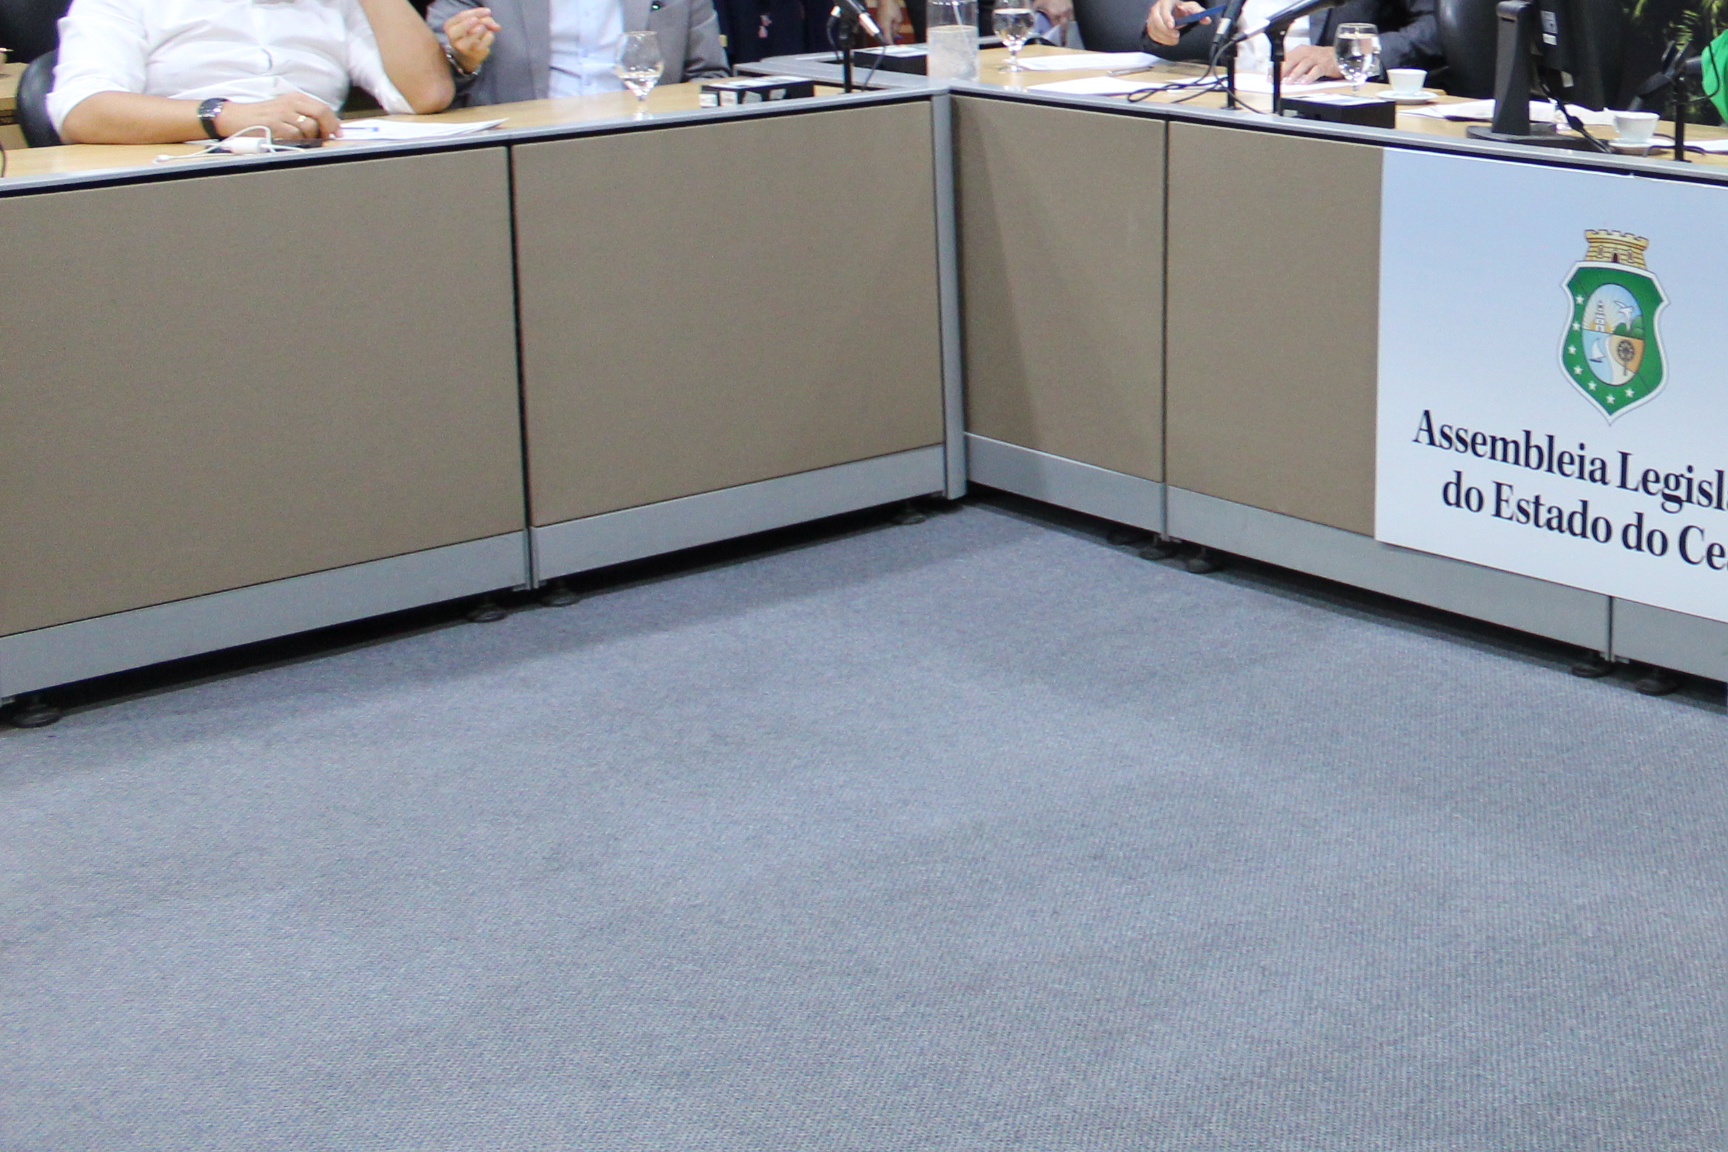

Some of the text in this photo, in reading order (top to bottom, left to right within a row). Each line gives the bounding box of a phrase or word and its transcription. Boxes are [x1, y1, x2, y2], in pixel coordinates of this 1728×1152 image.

[1412, 409, 1608, 487] Assembleia
[1442, 470, 1485, 514] do
[1491, 480, 1613, 545] Estado
[1621, 511, 1669, 558] do
